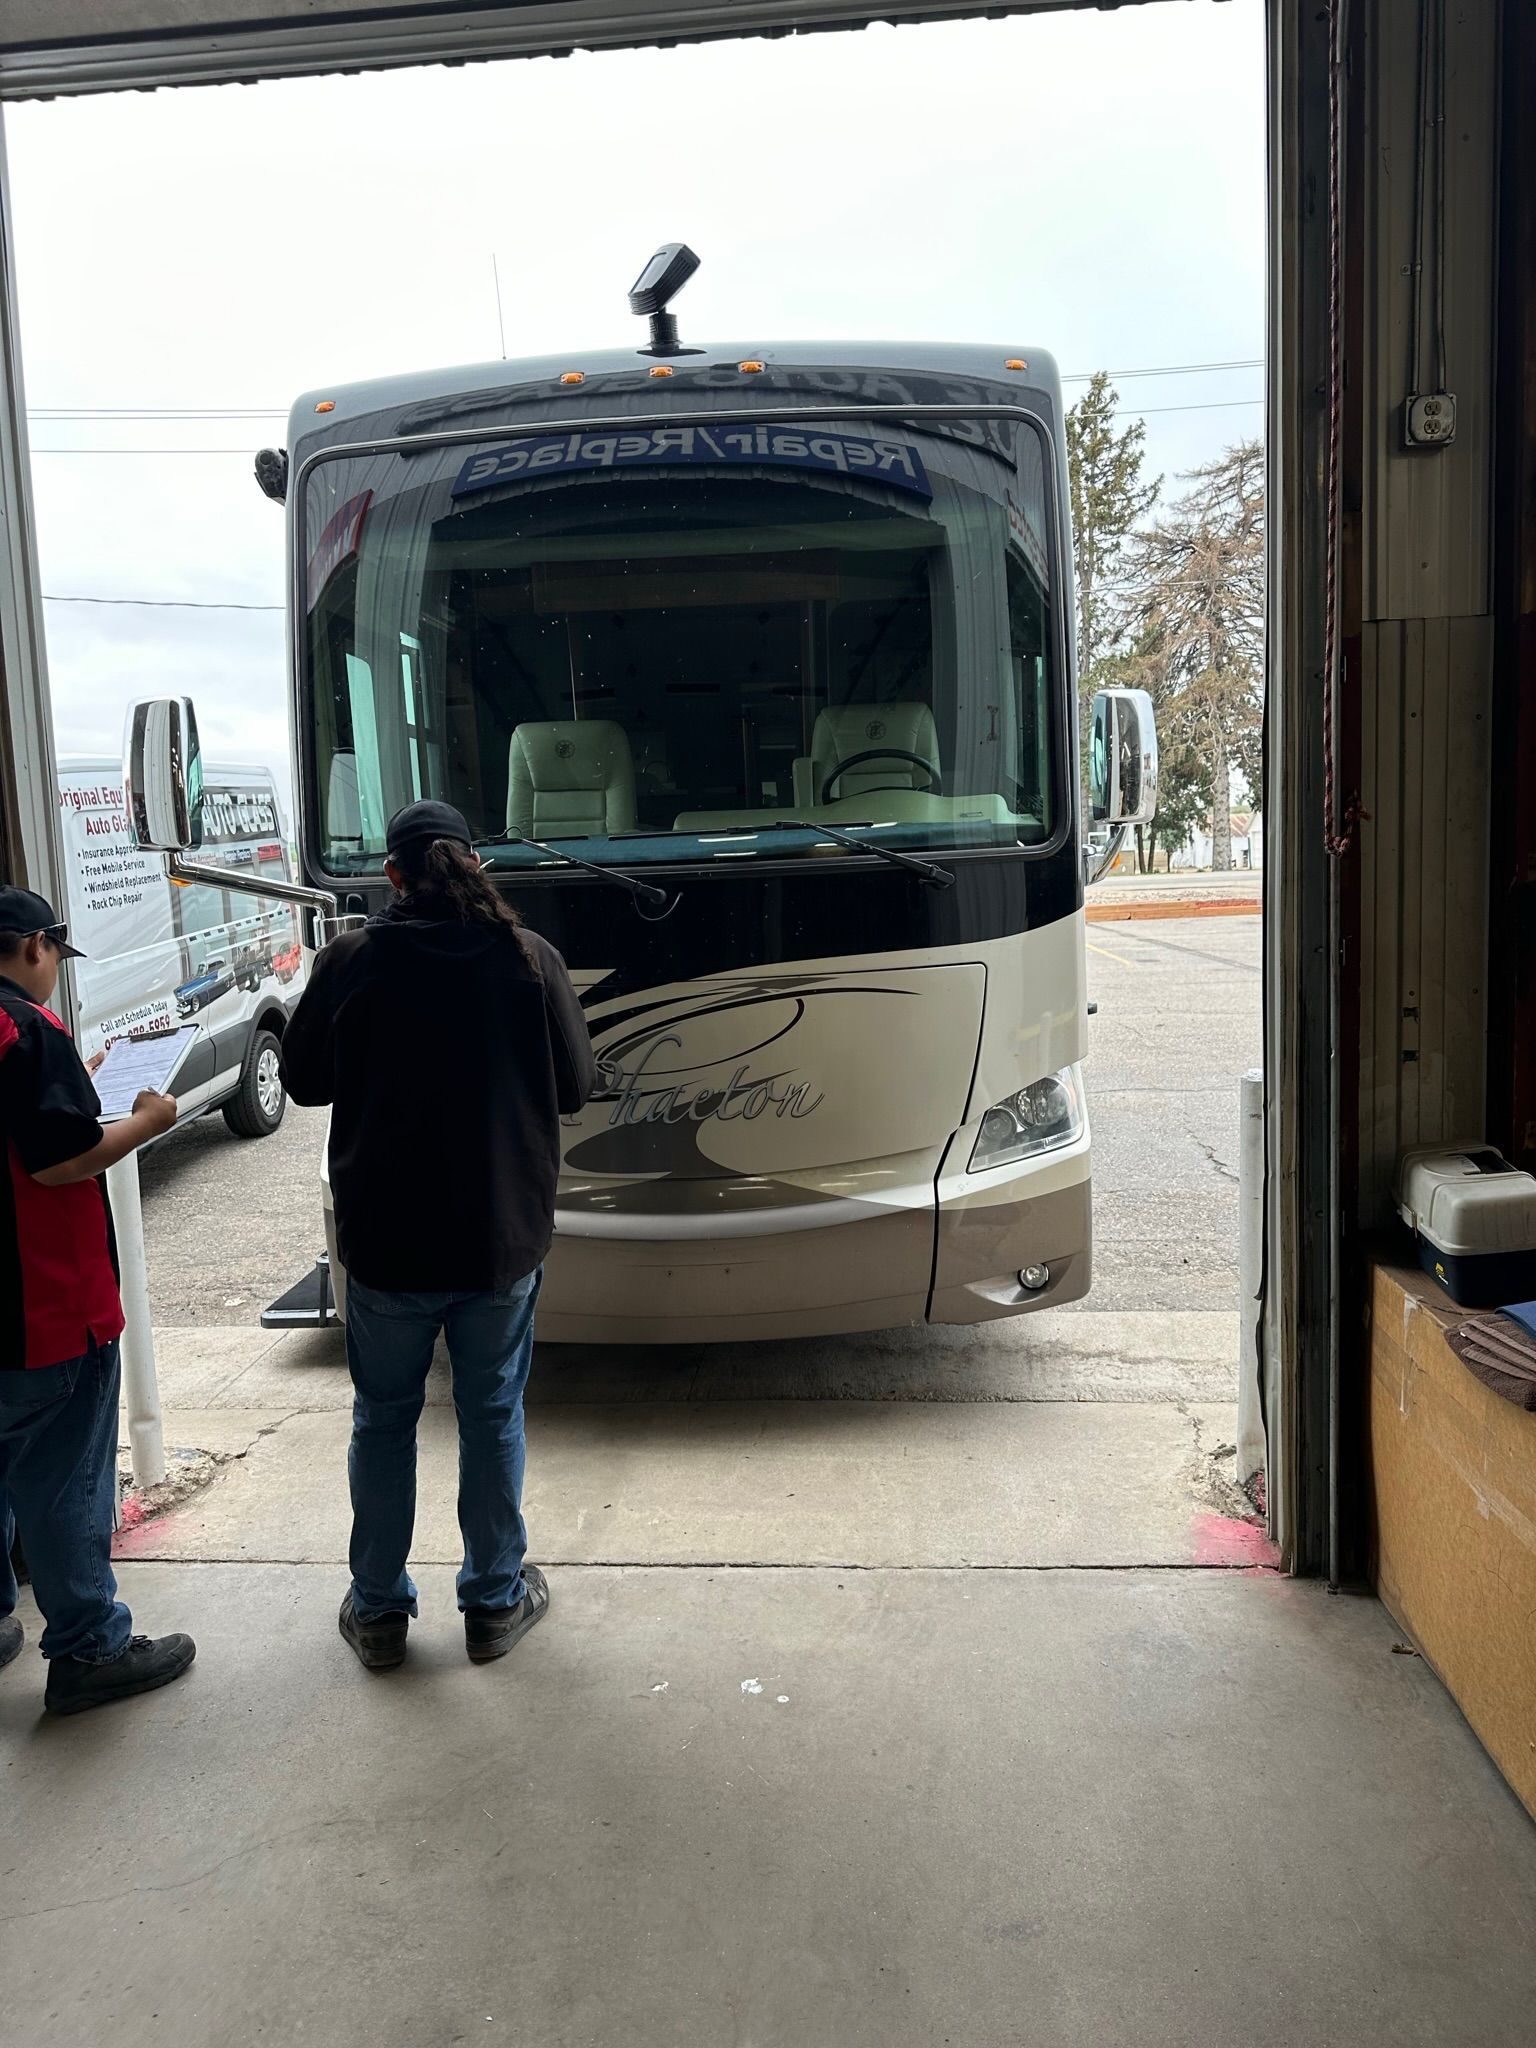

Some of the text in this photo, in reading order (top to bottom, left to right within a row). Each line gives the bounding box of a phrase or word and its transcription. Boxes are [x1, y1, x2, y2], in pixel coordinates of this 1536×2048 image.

[201, 793, 275, 836] AUTO GLASS
[86, 817, 111, 836] Auto
[81, 848, 114, 860] Insurance
[85, 859, 145, 877] Free Mobile Service
[88, 872, 161, 893] Windshield Replacement
[92, 891, 142, 910] Rock Chip Repair
[100, 1000, 168, 1034] Call and Schedule Today
